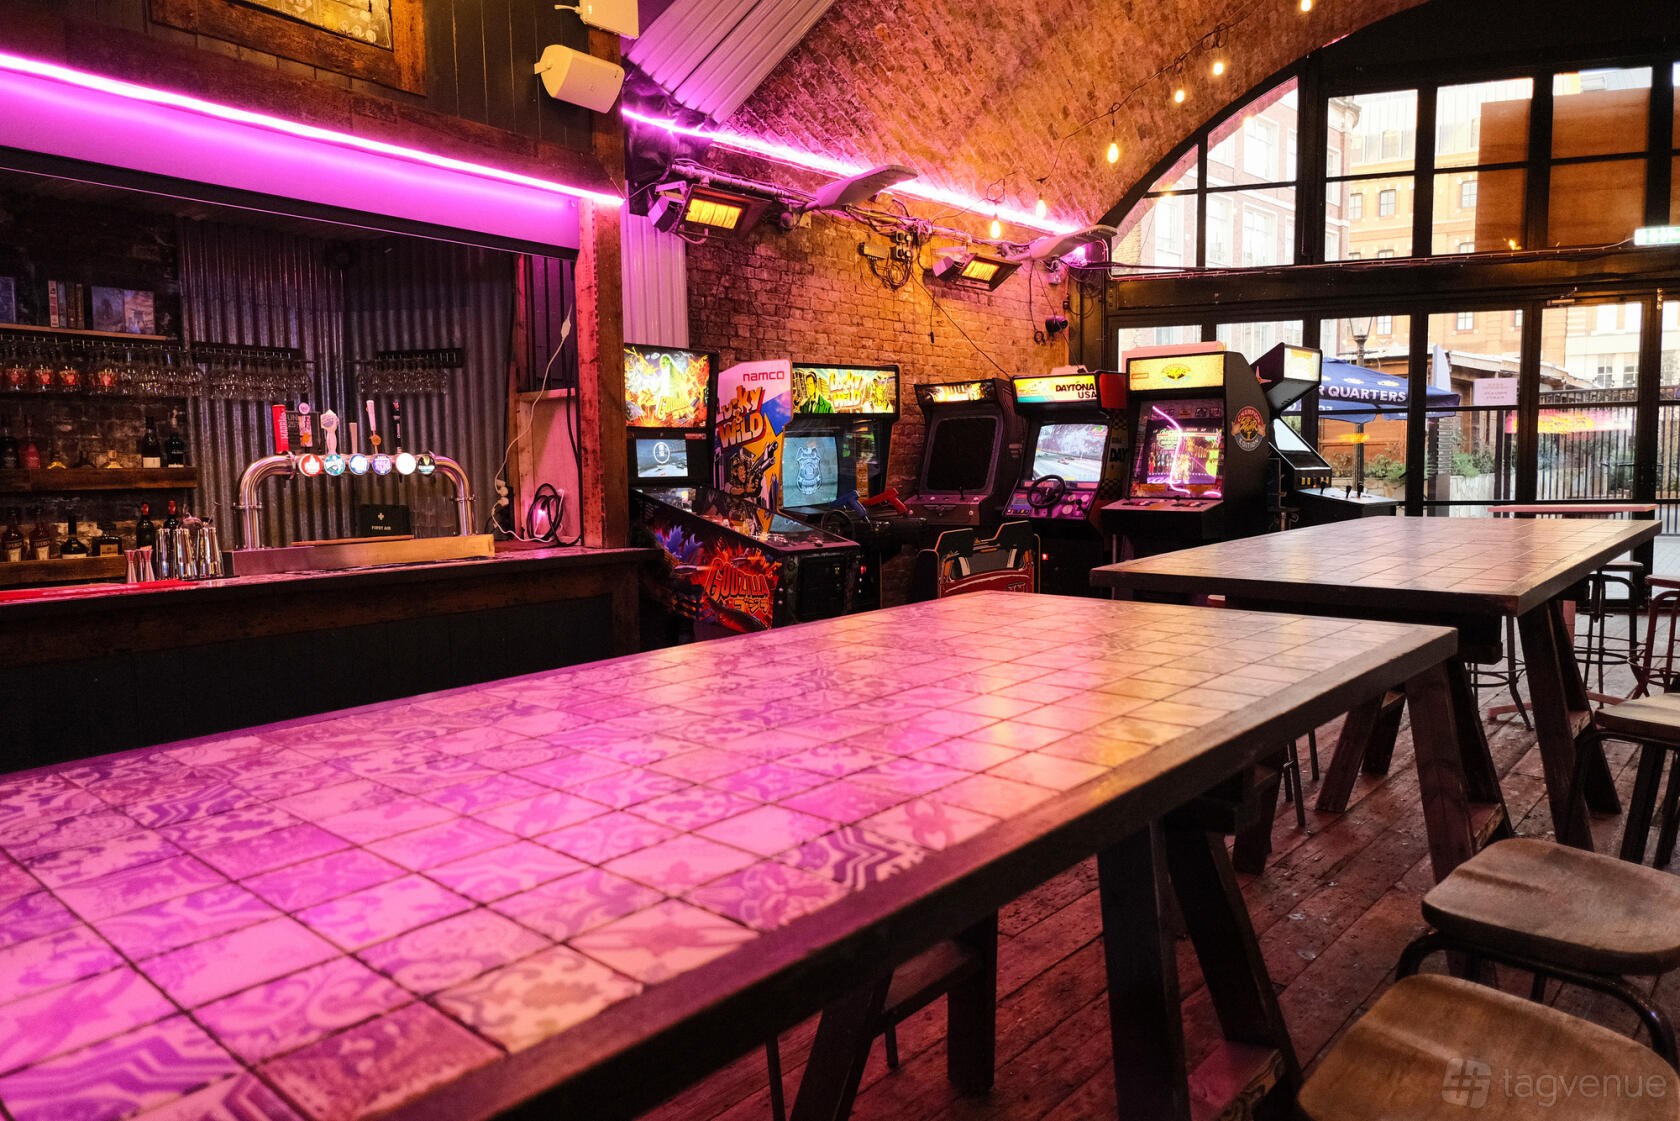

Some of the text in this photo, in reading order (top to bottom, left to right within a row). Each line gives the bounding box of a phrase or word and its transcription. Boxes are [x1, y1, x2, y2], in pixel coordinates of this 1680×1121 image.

[743, 371, 785, 382] namco
[1055, 383, 1095, 393] DAYTONA
[1077, 390, 1097, 399] USA
[1328, 385, 1409, 403] QUARTERS
[704, 557, 769, 602] GODZILLA
